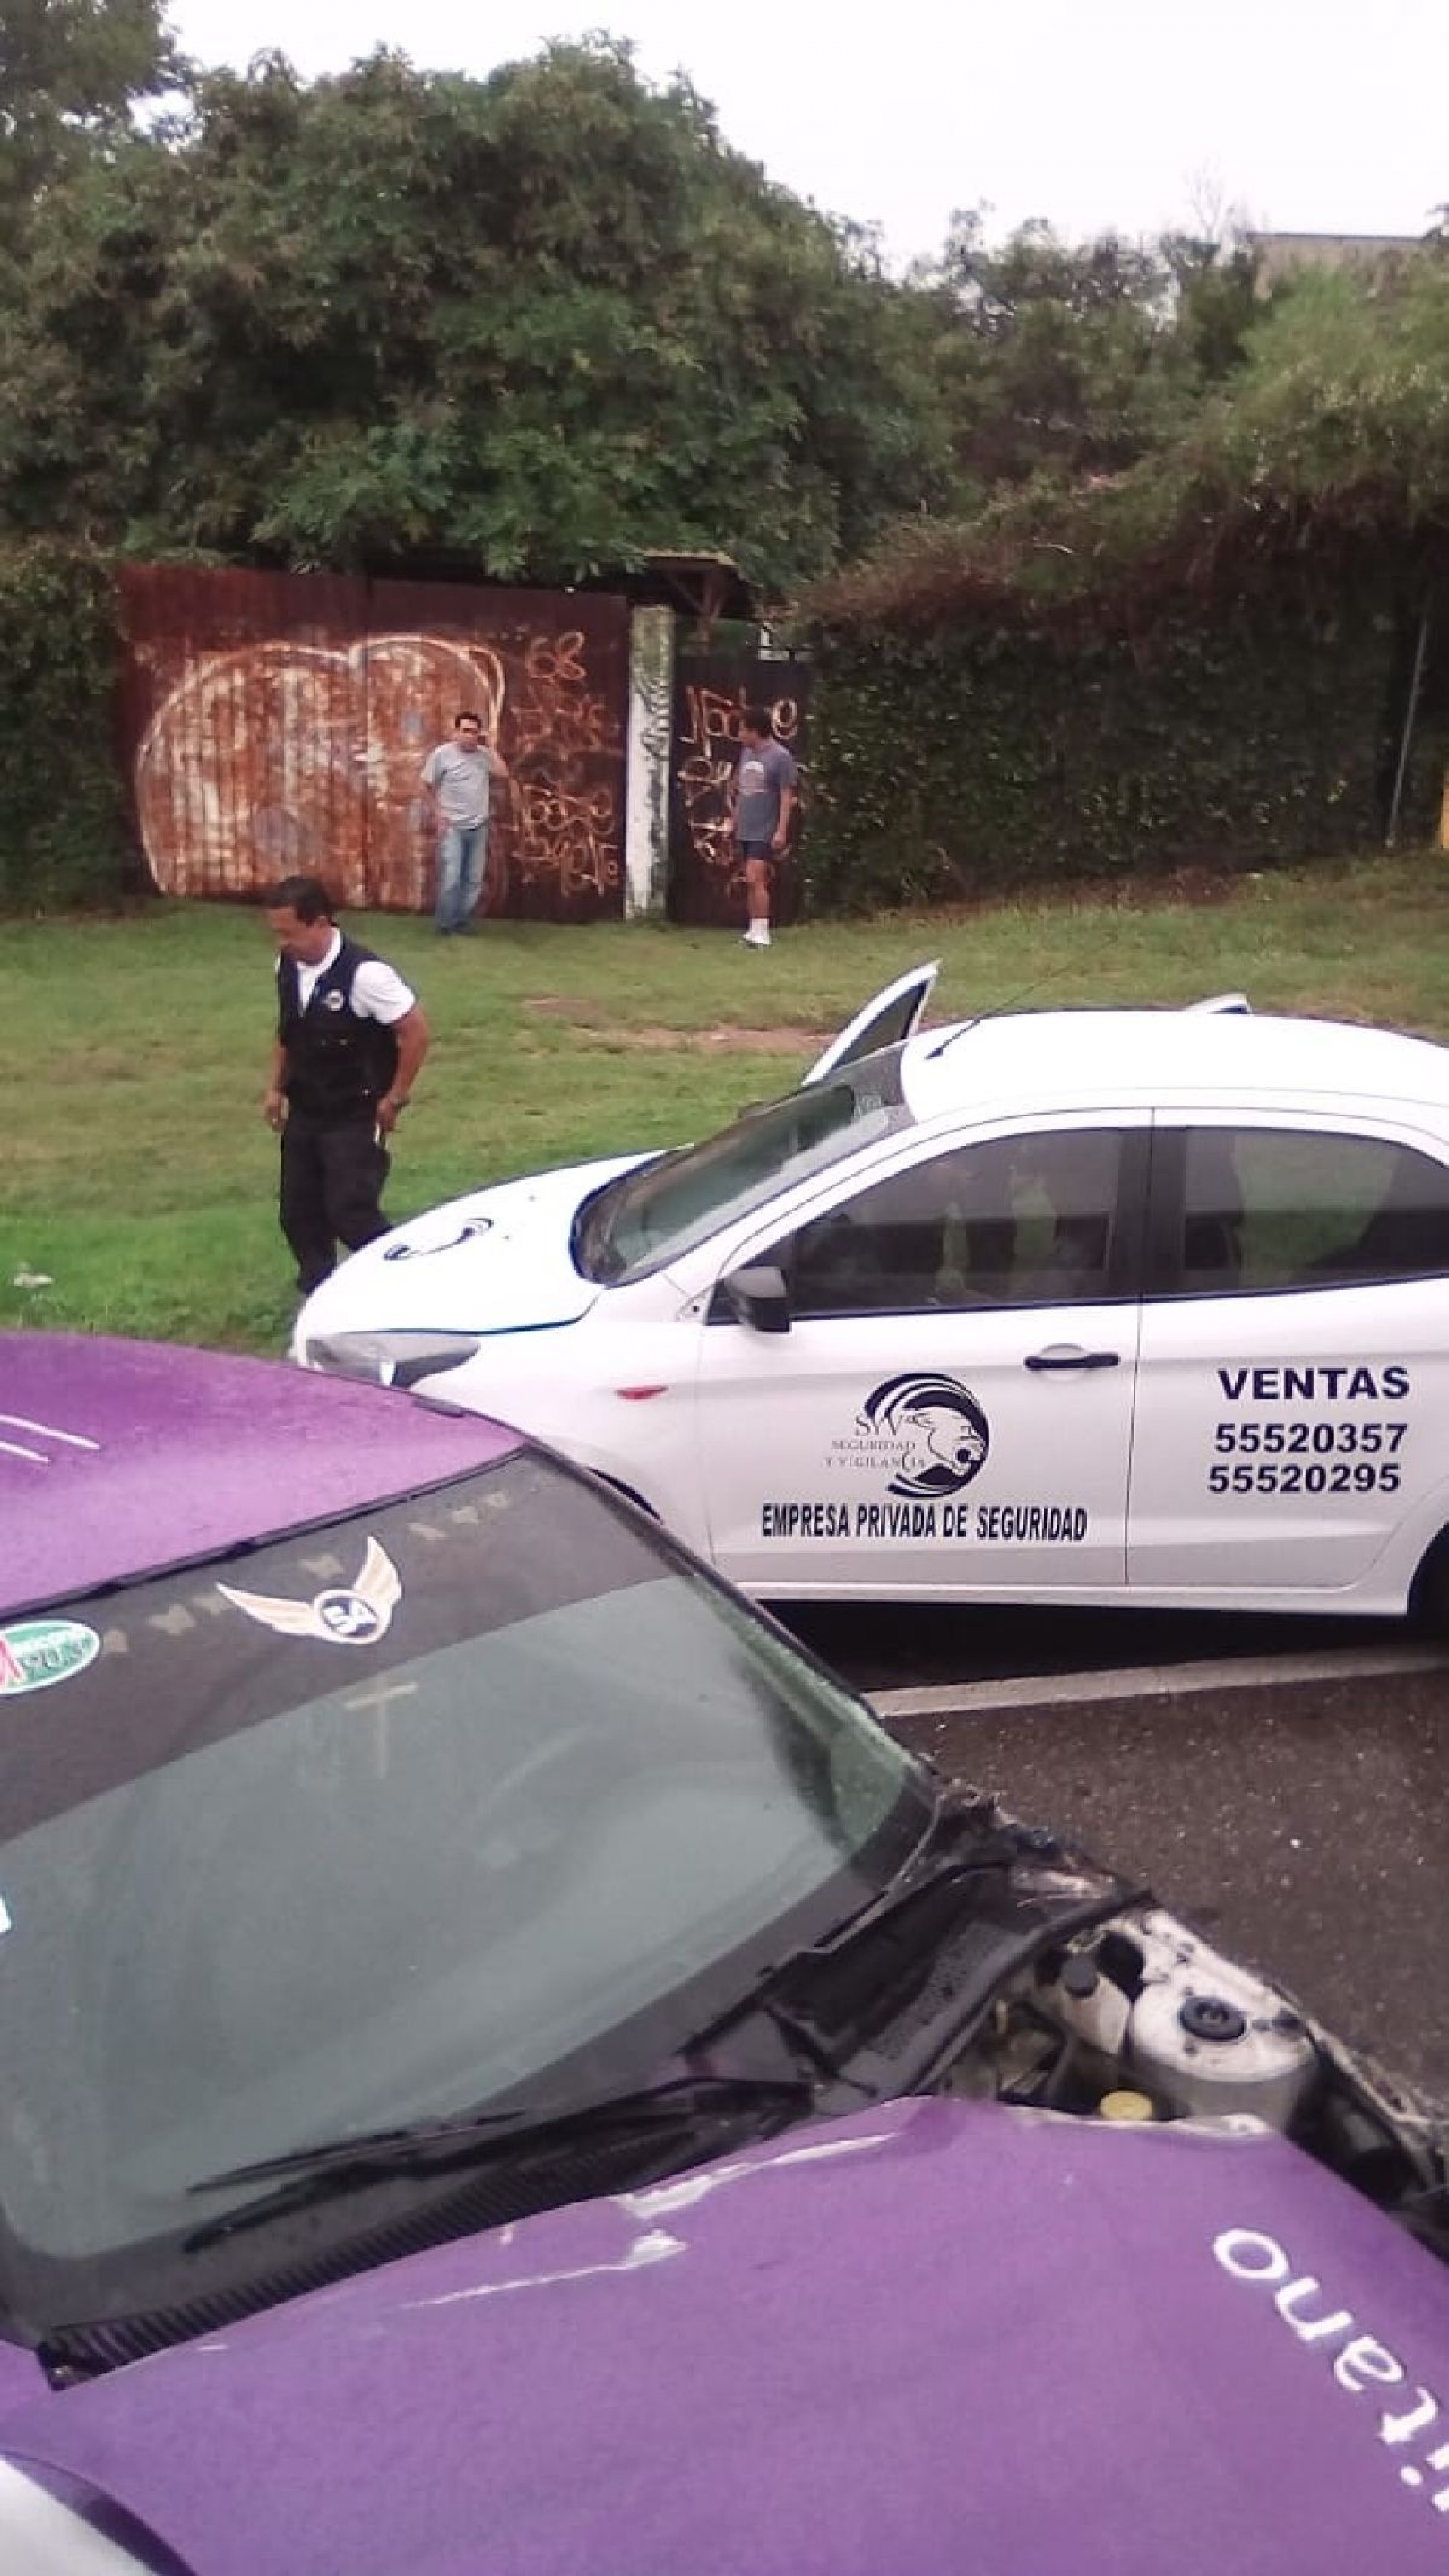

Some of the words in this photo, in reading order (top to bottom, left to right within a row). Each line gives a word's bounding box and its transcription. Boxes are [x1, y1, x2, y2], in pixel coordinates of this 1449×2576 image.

[1218, 1366, 1410, 1399] VENTAS
[831, 1439, 916, 1451] SEGURIDAD
[1214, 1423, 1407, 1452] 55520357
[825, 1457, 832, 1467] Y
[837, 1455, 925, 1470] VIGILANCIA
[1208, 1463, 1401, 1493] 55520295
[762, 1503, 850, 1538] EMPRESA
[856, 1503, 937, 1538] PRIVADA
[943, 1504, 968, 1538] DE
[977, 1506, 1088, 1541] SEGURIDAD
[1212, 2228, 1449, 2513] itano
